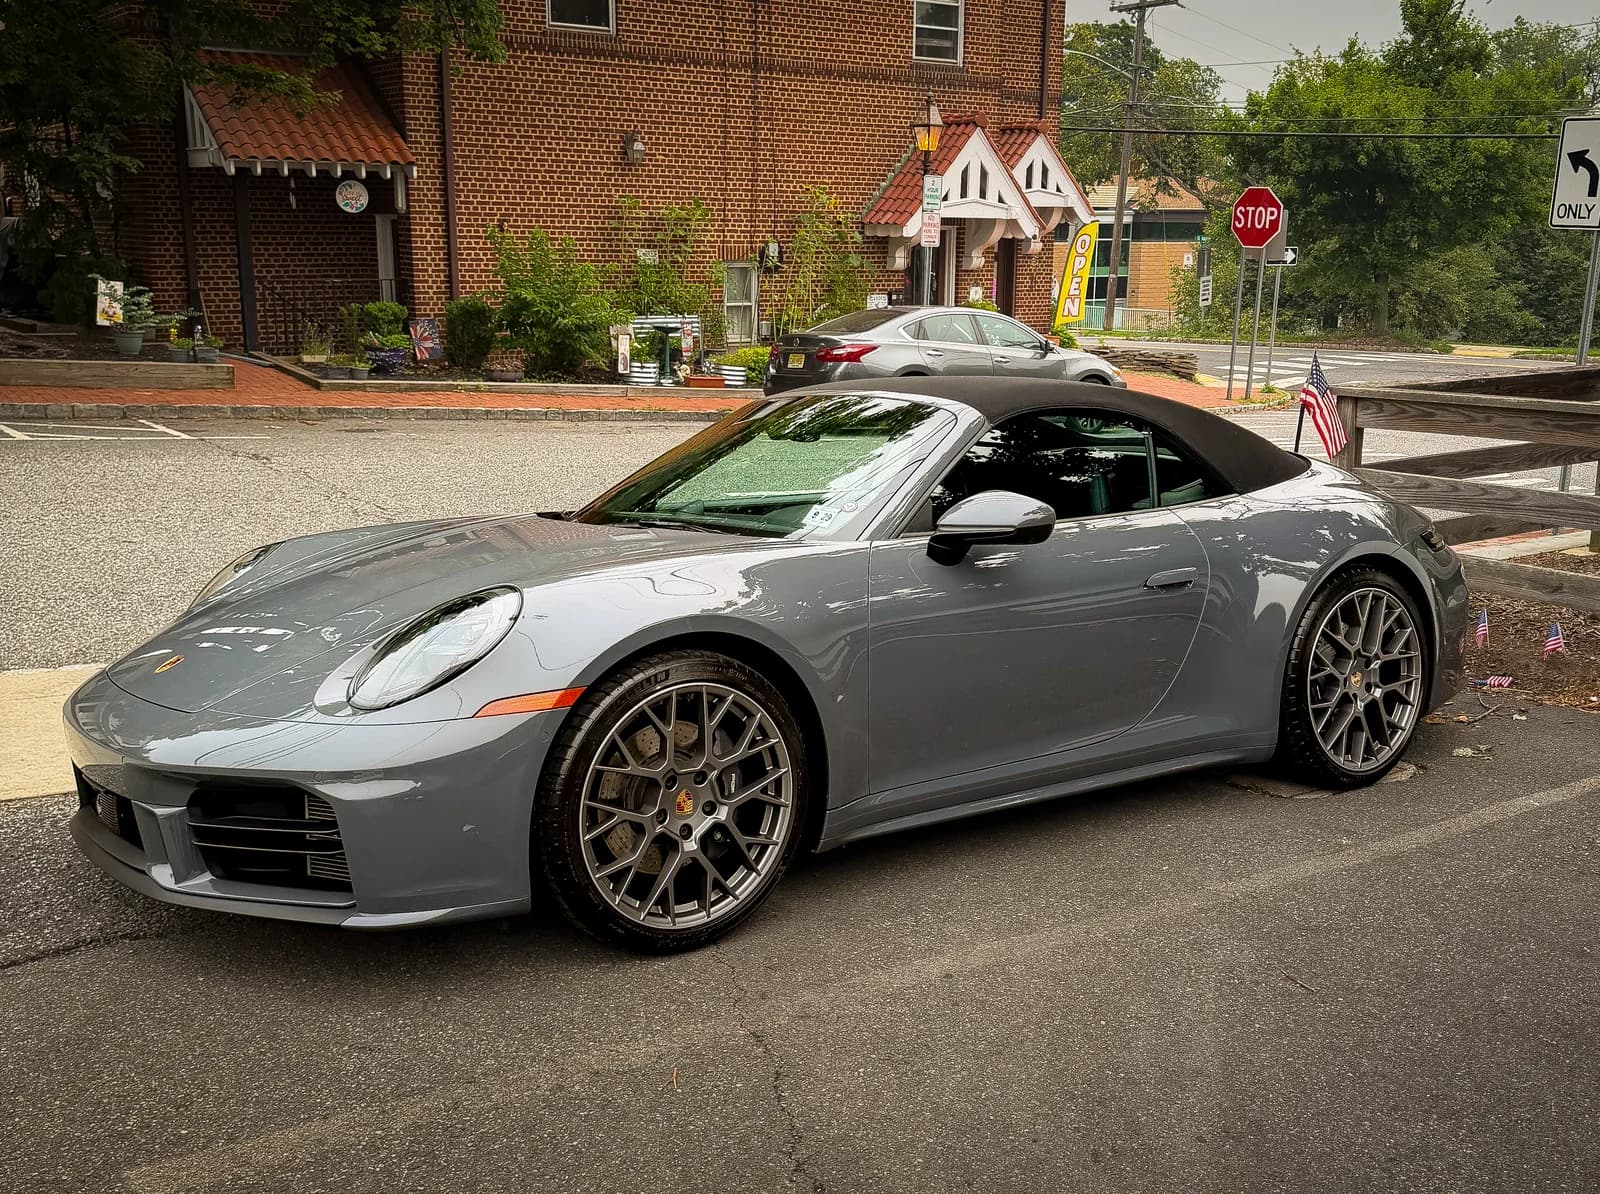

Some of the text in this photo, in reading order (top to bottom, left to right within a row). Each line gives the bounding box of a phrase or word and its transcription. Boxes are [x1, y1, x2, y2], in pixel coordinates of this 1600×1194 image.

[1235, 206, 1278, 229] STOP
[1557, 203, 1596, 219] ONLY
[1062, 233, 1092, 317] OPEN
